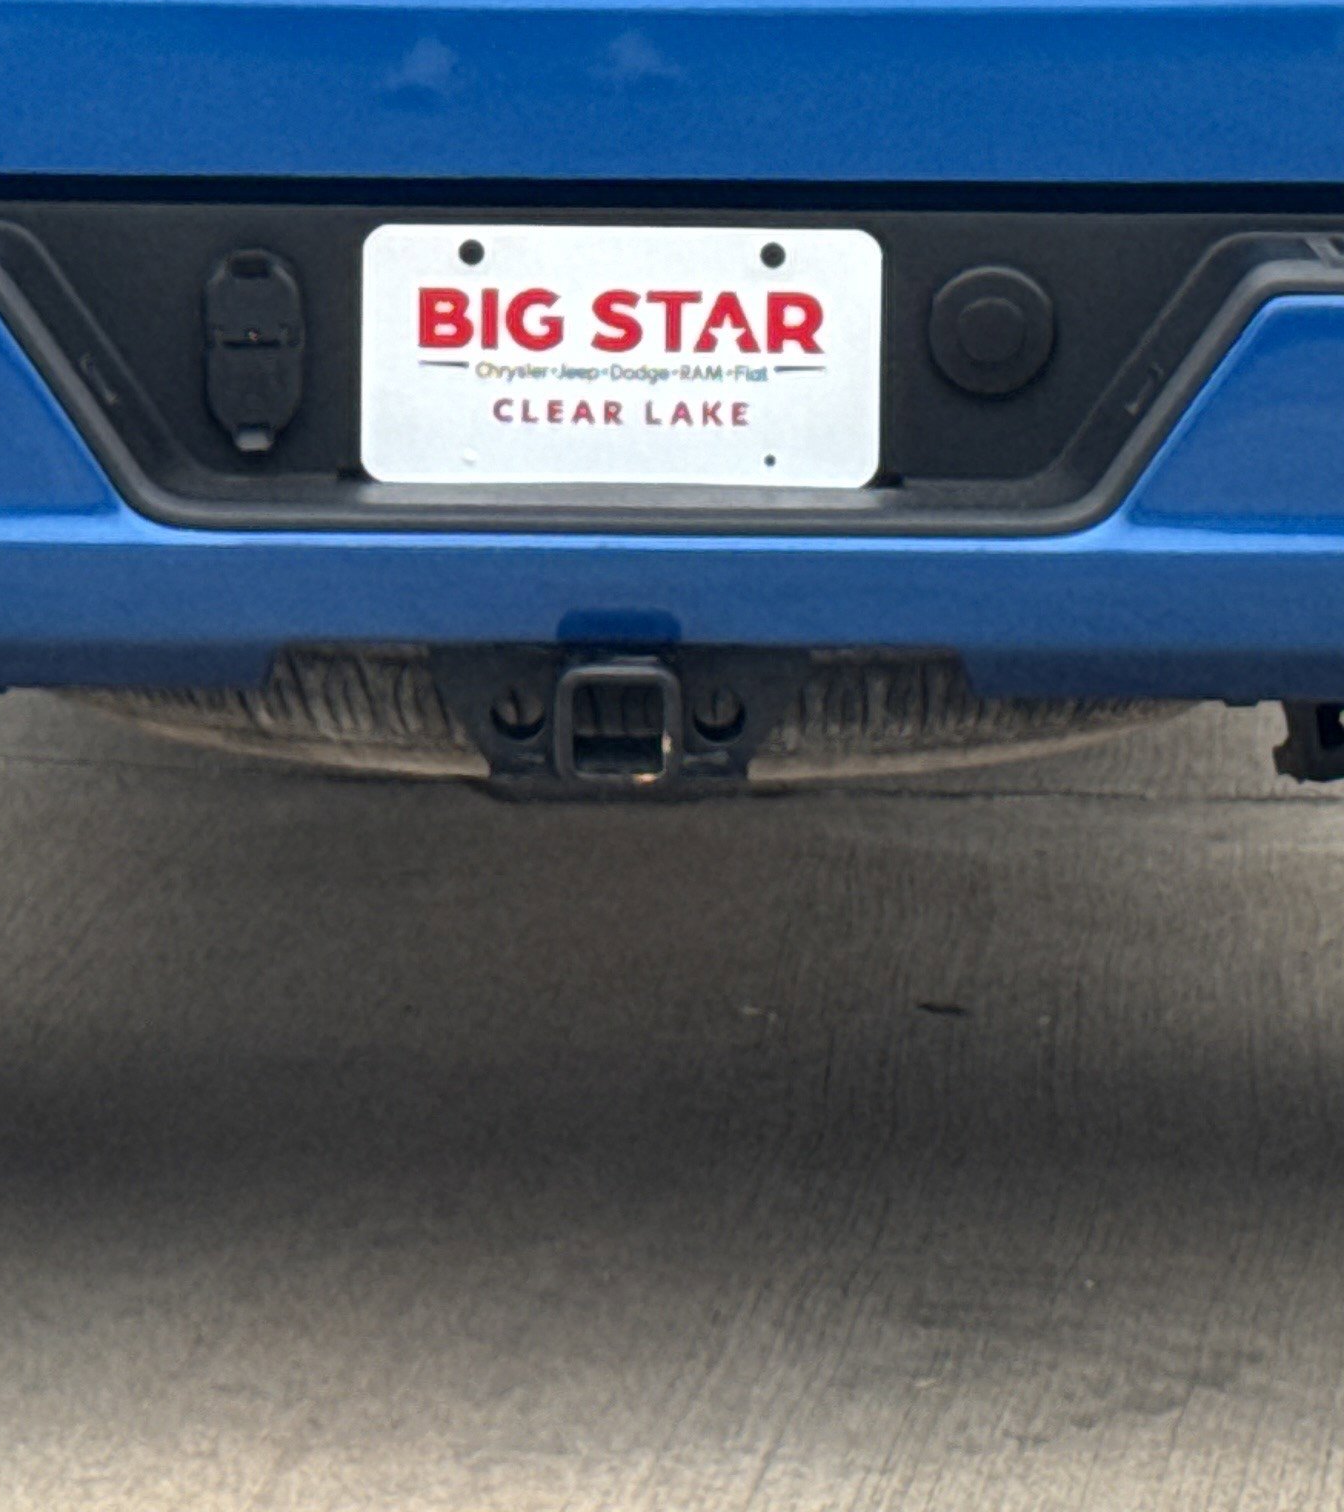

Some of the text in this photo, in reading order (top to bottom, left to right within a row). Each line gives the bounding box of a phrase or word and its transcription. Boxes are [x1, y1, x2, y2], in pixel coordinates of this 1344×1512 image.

[417, 286, 826, 354] BIG STAR
[492, 397, 750, 427] CLEAR LAKE
